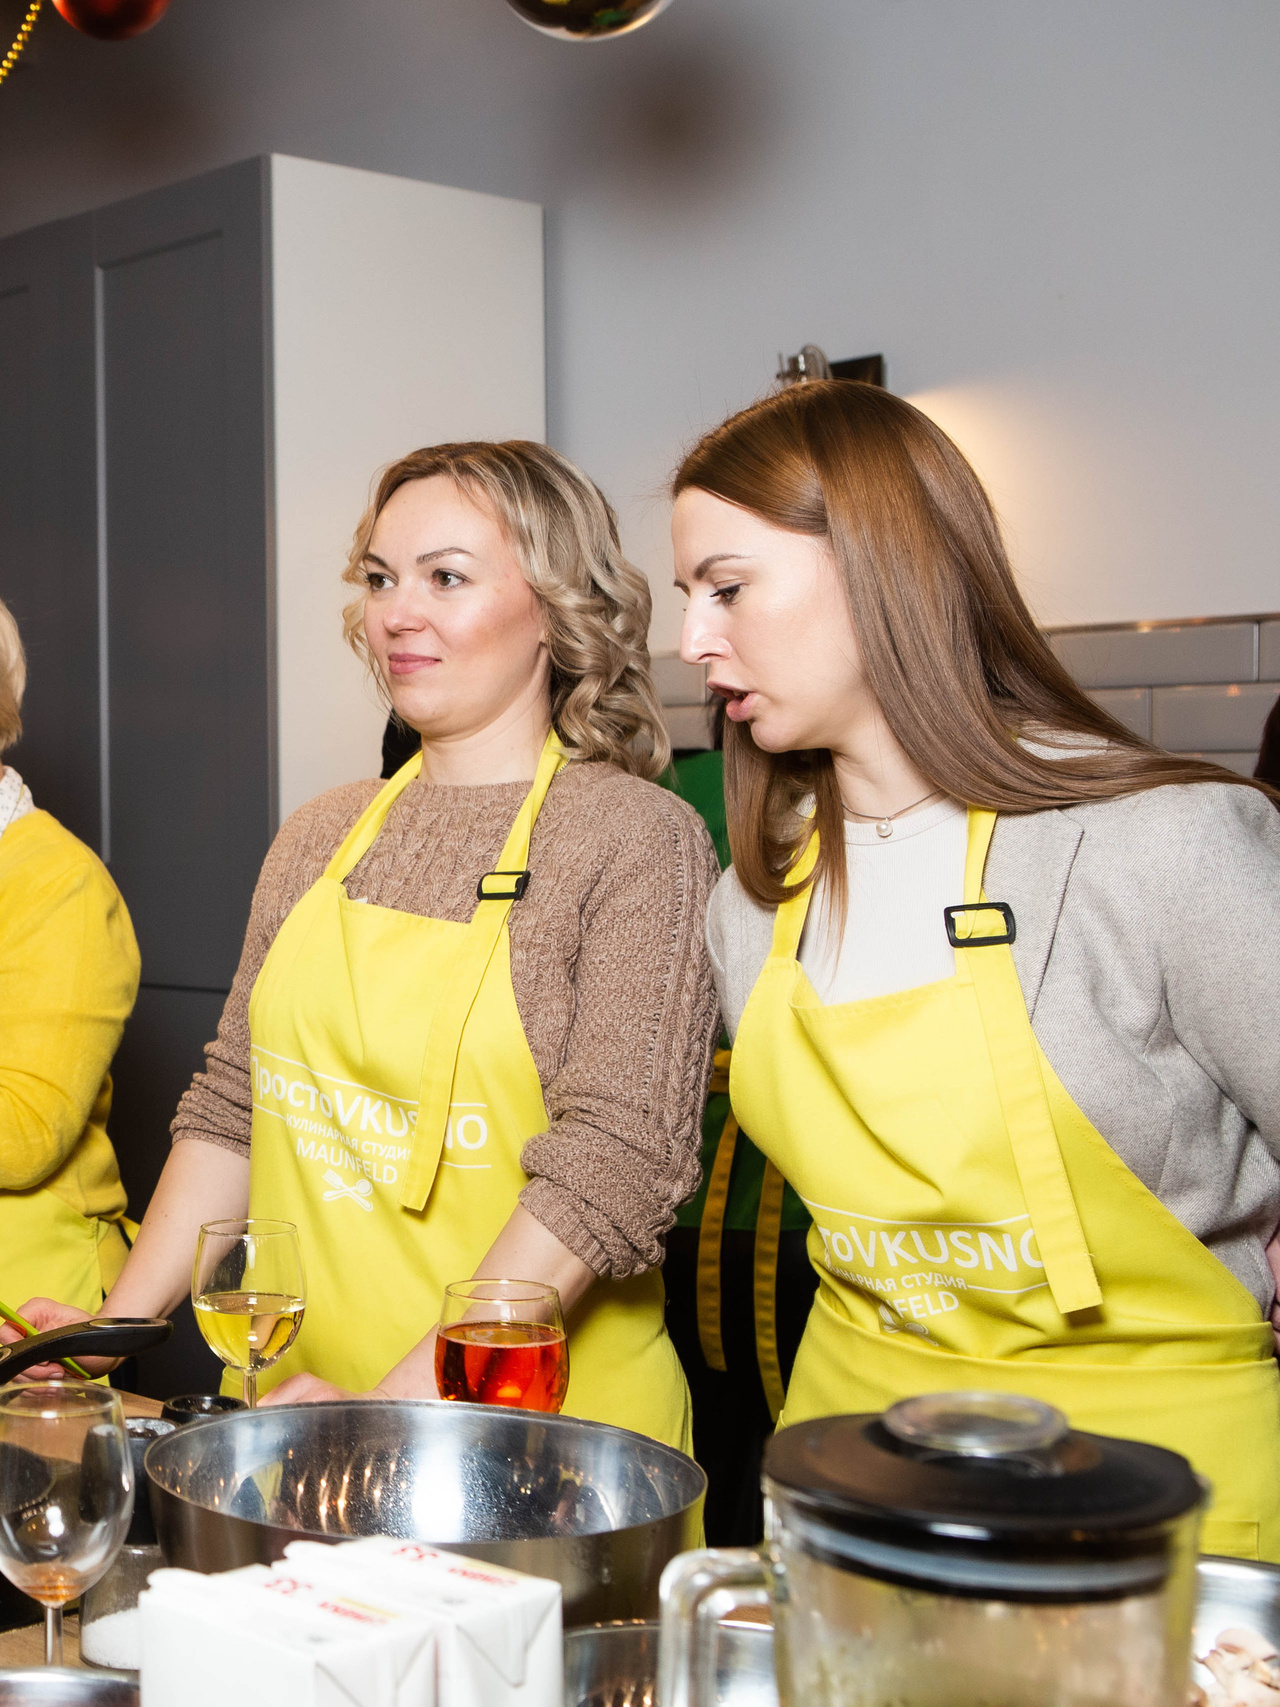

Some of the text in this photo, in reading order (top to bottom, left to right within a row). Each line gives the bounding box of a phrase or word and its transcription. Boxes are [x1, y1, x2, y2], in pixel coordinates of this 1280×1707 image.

[286, 1112, 359, 1151] КУЛИНАРНАЯ
[296, 1137, 398, 1185] MAUNFELD
[900, 1272, 968, 1291] СТУДИЯ
